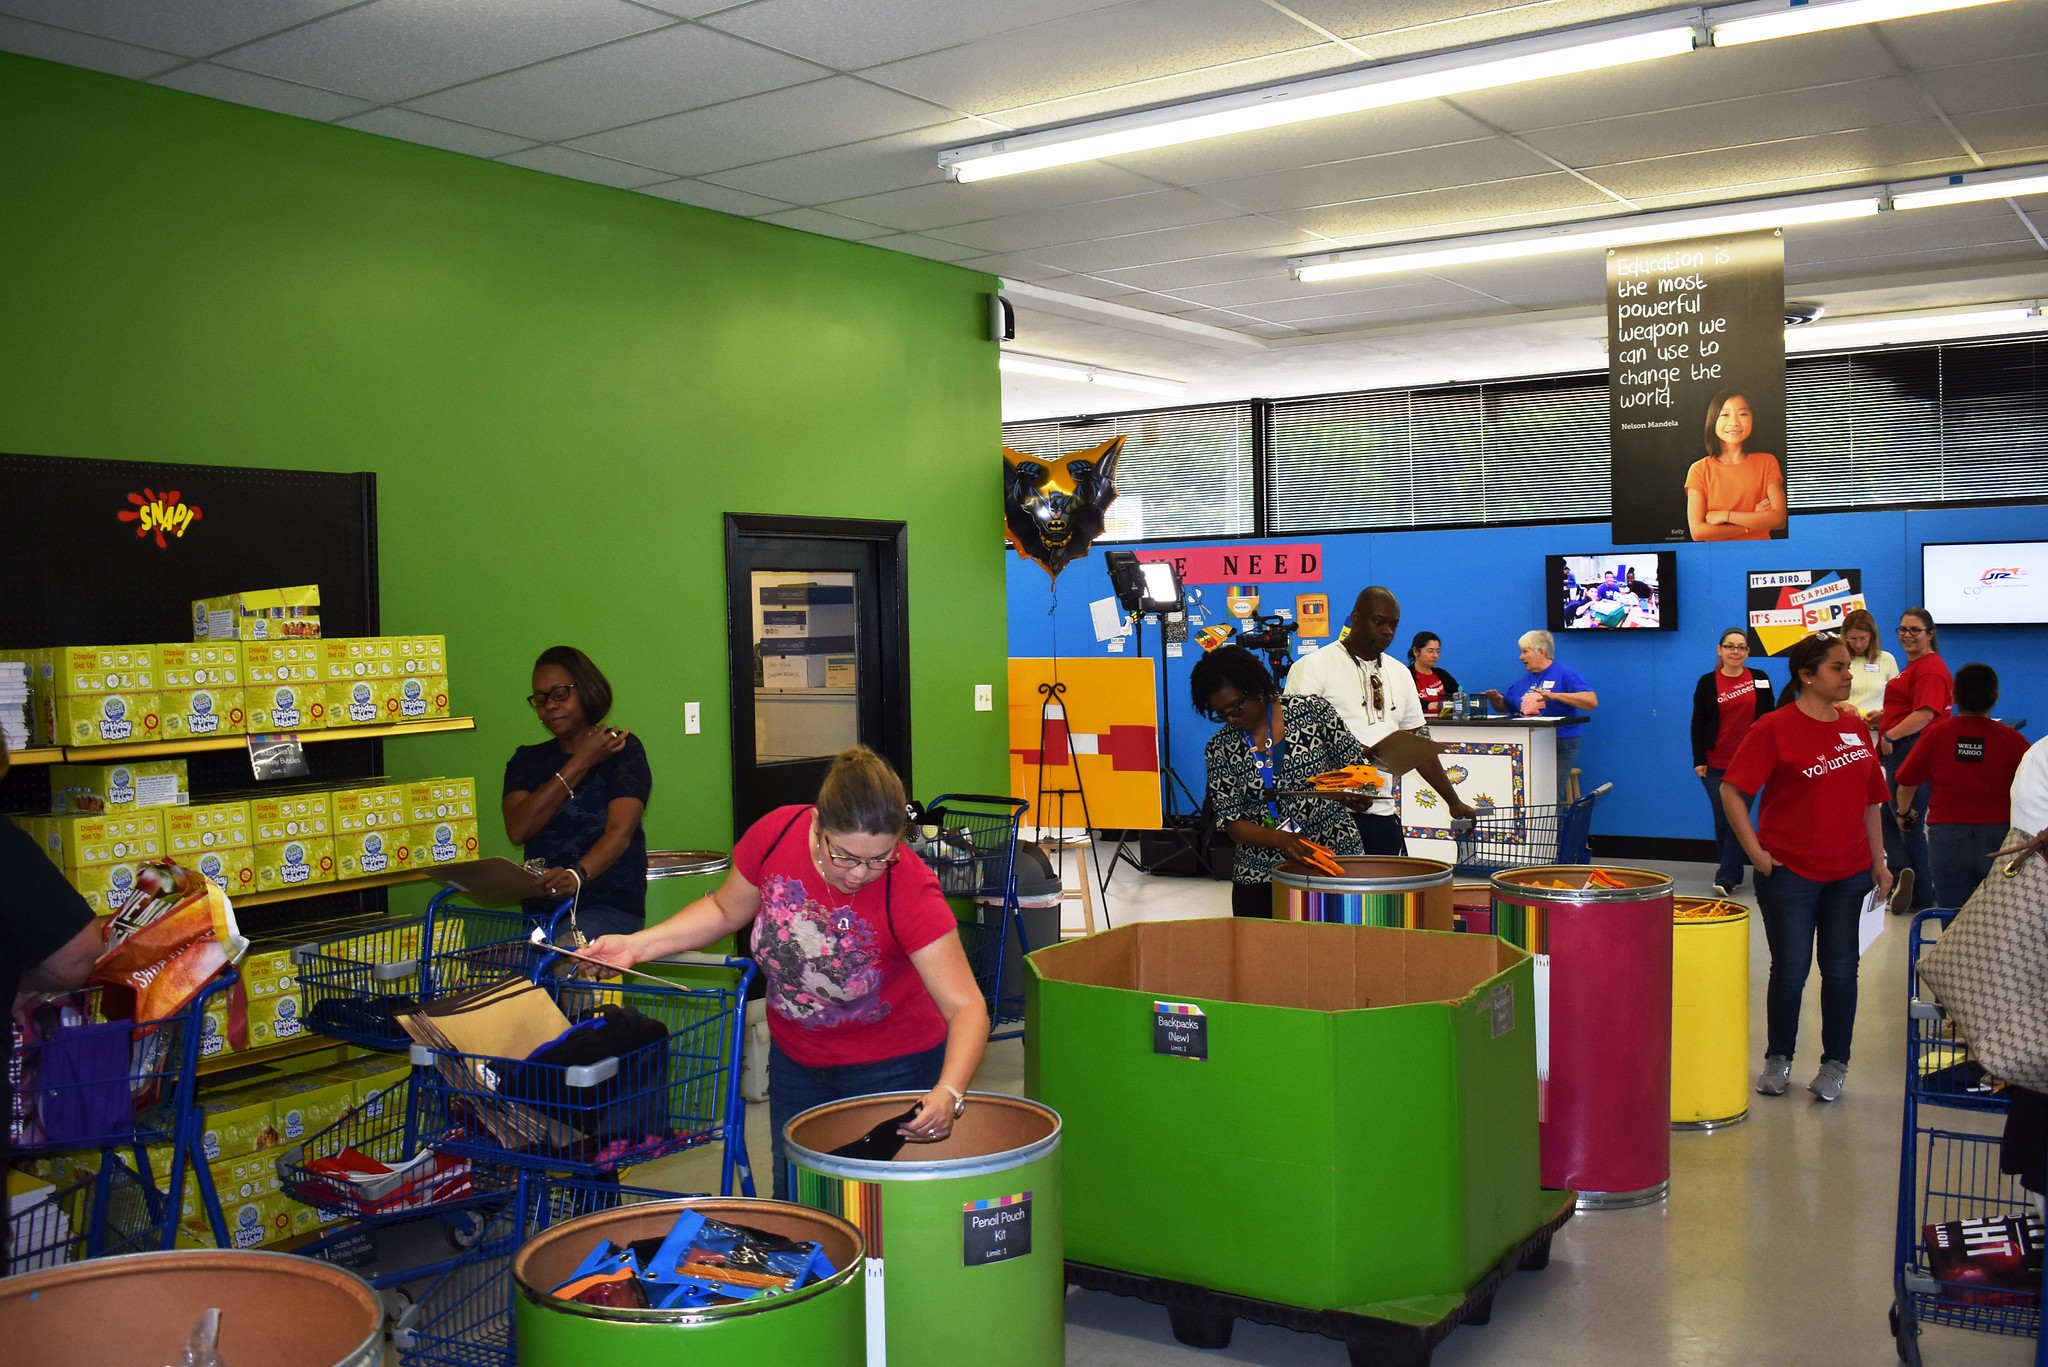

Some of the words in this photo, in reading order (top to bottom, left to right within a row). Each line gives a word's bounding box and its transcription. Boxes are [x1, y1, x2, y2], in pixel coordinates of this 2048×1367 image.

[1618, 251, 1704, 278] Education
[1715, 247, 1730, 265] is
[1618, 281, 1648, 298] the
[1658, 273, 1708, 294] most
[1618, 294, 1700, 329] powerful
[1618, 320, 1688, 348] weapon
[1699, 317, 1726, 335] we
[1620, 348, 1647, 365] can
[1658, 344, 1689, 362] use
[1700, 340, 1720, 358] to
[1620, 366, 1680, 392] change
[1690, 362, 1722, 381] the
[1620, 386, 1674, 408] world.
[1648, 420, 1679, 428] Mandela
[140, 500, 194, 538] SNAP!
[1223, 554, 1317, 576] NEED
[1752, 576, 1767, 585] IT'S
[1770, 576, 1776, 584] A
[1792, 594, 1806, 604] IT'S
[1808, 592, 1814, 600] A
[1751, 613, 1770, 624] IT'S
[74, 652, 96, 660] Display
[164, 650, 186, 658] Display
[248, 646, 269, 656] Display
[1958, 742, 1983, 750] WELLS
[412, 788, 429, 796] Display
[338, 796, 358, 804] Display
[257, 804, 278, 812] Display
[349, 804, 357, 812] Up
[170, 814, 192, 822] Display
[268, 812, 276, 820] Up
[80, 824, 104, 832] Display
[184, 822, 192, 830] Up
[94, 832, 102, 840] Up
[432, 844, 457, 855] Birthday
[360, 854, 388, 866] Birthday
[434, 852, 456, 862] Bubbles
[281, 865, 310, 876] Birthday
[363, 862, 387, 872] Bubbles
[282, 873, 310, 884] Bubbles
[250, 960, 270, 968] Display
[1158, 1016, 1200, 1030] Backpacks
[1168, 1031, 1190, 1043] (New)
[972, 1212, 1000, 1228] Pencil
[1001, 1208, 1026, 1224] Pouch
[236, 1226, 264, 1239] Birthday
[994, 1229, 1007, 1242] Kit
[238, 1234, 263, 1248] Bubbles
[352, 1244, 372, 1254] Bubbles
